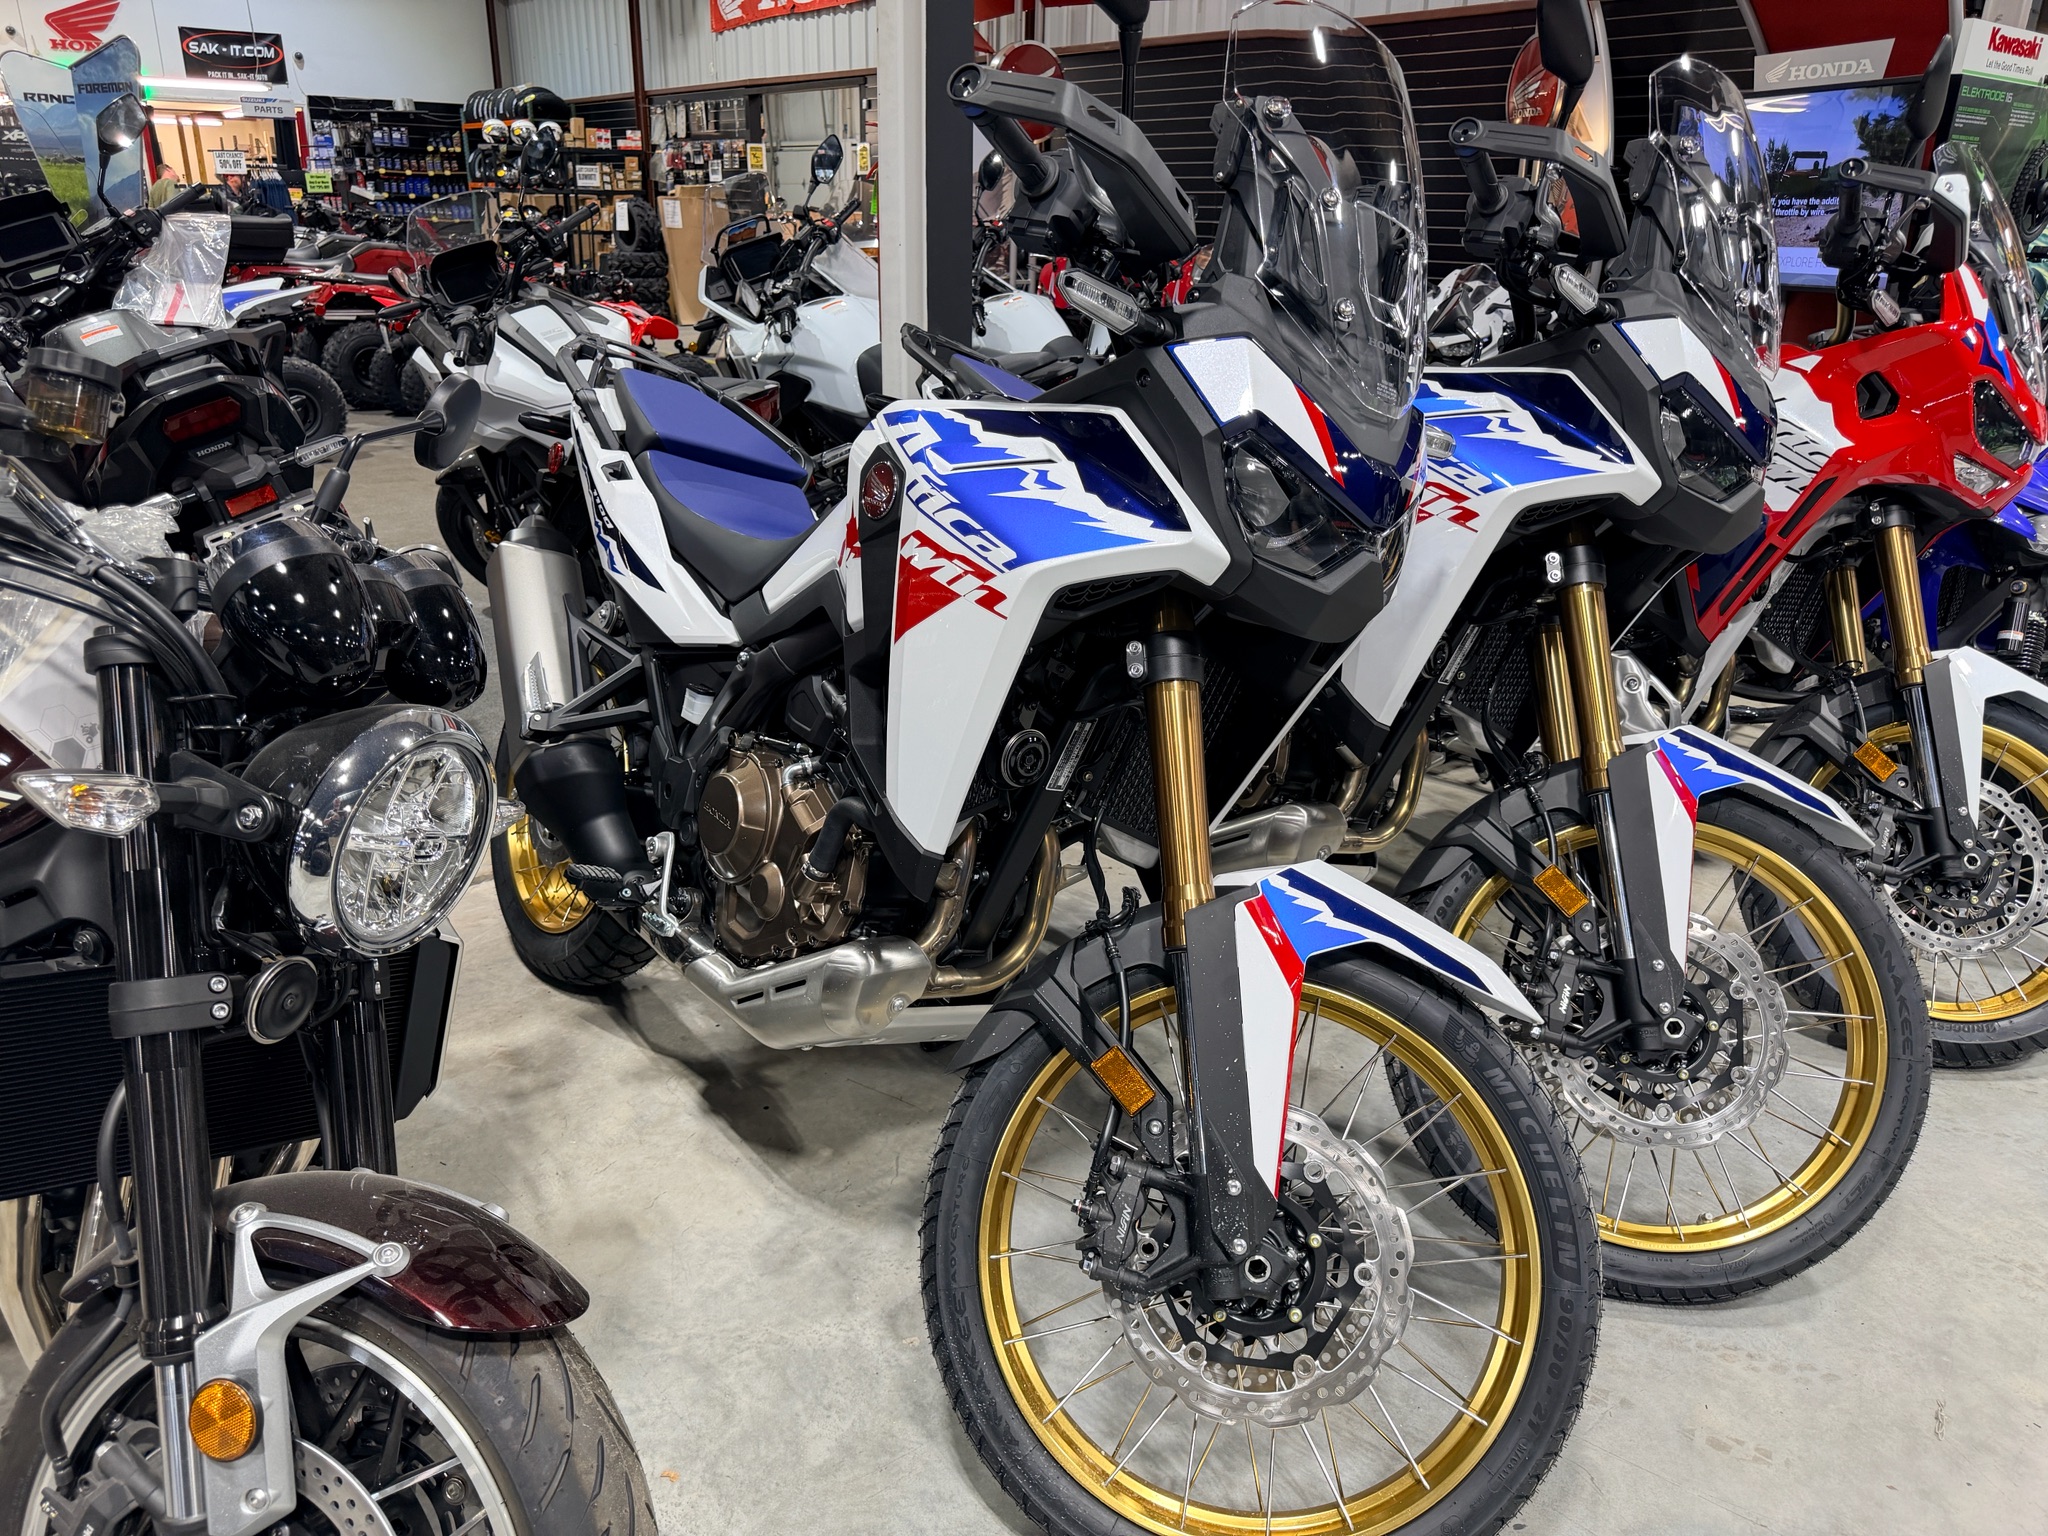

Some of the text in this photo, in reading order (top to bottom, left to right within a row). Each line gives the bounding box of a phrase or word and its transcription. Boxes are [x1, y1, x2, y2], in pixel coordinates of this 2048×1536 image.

[49, 39, 103, 52] HON
[188, 41, 219, 54] SAK
[230, 45, 275, 58] IT.COM
[1987, 26, 2044, 60] Kawasaki
[1788, 58, 1875, 81] HONDA
[1985, 59, 2034, 75] Let the Good Times Roll
[77, 81, 134, 95] FOREMAN
[1961, 85, 2013, 103] ELEKTRODE 16
[23, 92, 75, 105] RANC
[254, 106, 283, 114] PARTS
[1510, 107, 1544, 119] HONDA
[232, 159, 242, 169] OFF
[1778, 198, 1790, 207] you
[1792, 197, 1807, 206] have
[1809, 197, 1820, 206] the
[1821, 197, 1840, 206] addit
[1775, 208, 1799, 216] throttle
[1800, 209, 1808, 217] by
[1778, 256, 1813, 268] XPLORE
[1368, 336, 1408, 362] HONDA
[196, 441, 232, 457] HONDA
[593, 489, 615, 529] 1100
[1461, 863, 1479, 885] 21
[1482, 1066, 1579, 1276] MICHELIN
[1548, 1296, 1575, 1381] 90/90
[1527, 1402, 1550, 1436] 21
